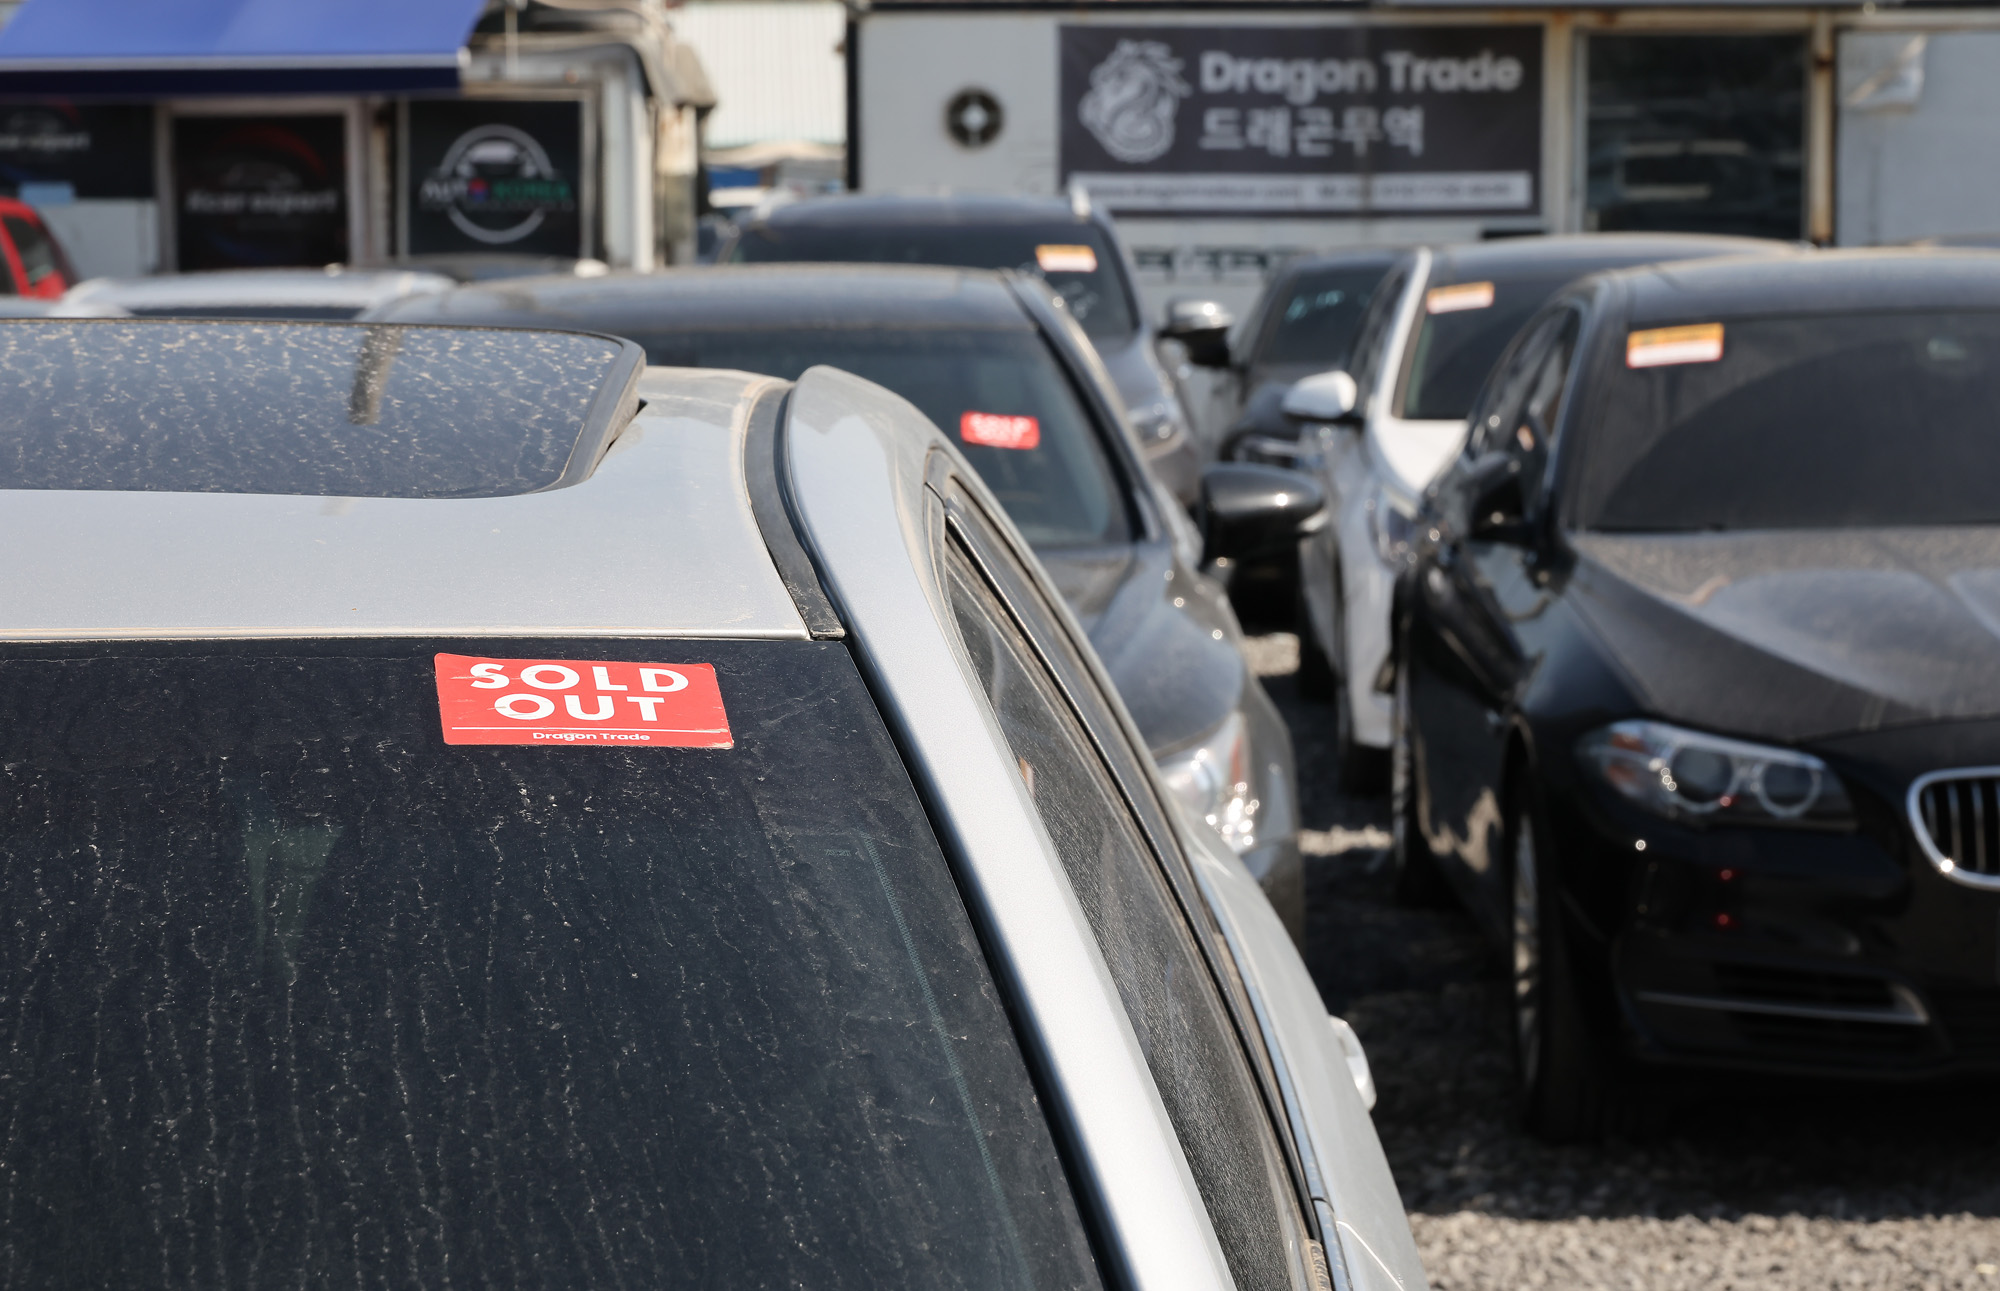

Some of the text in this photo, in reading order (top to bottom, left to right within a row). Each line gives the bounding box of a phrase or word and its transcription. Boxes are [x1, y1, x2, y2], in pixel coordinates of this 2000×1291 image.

[1200, 50, 1524, 105] Dragon Trade
[1199, 106, 1425, 157] 드래곤무역
[470, 663, 689, 693] SOLD
[494, 693, 665, 722] OUT
[533, 732, 651, 742] Dragon Trade
